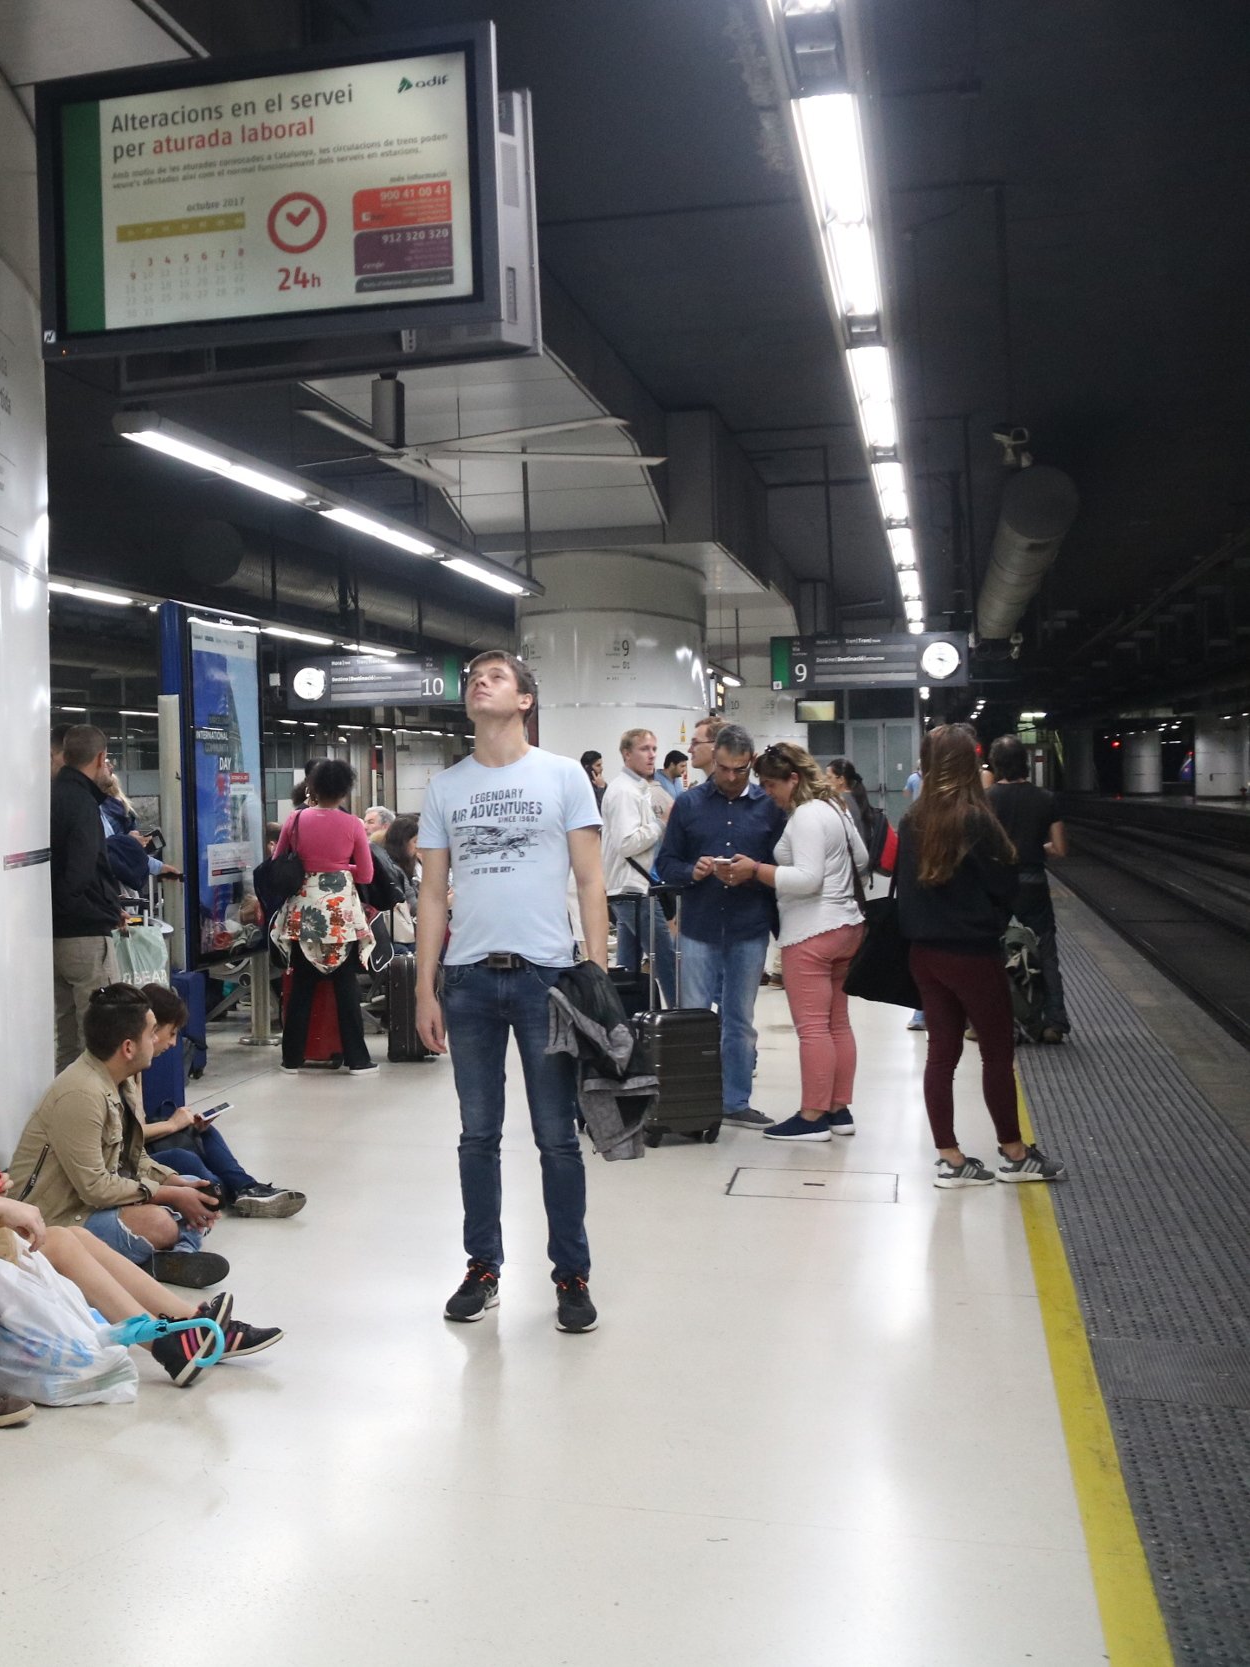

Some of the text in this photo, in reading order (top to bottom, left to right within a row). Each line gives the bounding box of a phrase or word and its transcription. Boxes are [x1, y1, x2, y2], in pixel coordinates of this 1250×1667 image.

[111, 83, 352, 133] Alteracions en el servei
[112, 116, 314, 164] per aturada laboral
[384, 139, 394, 147] de
[397, 136, 418, 146] trens
[420, 132, 448, 146] poden
[435, 185, 447, 194] 41
[222, 197, 244, 208] 2017
[382, 234, 402, 244] 912
[278, 266, 321, 291] 24h
[622, 640, 629, 656] 9
[795, 663, 807, 682] 9
[422, 677, 445, 696] 10
[196, 730, 228, 740] INTERNATIONAL
[219, 757, 231, 770] DAY
[470, 788, 523, 805] LEGENDARY
[452, 801, 542, 824] AIR ADVENTURES
